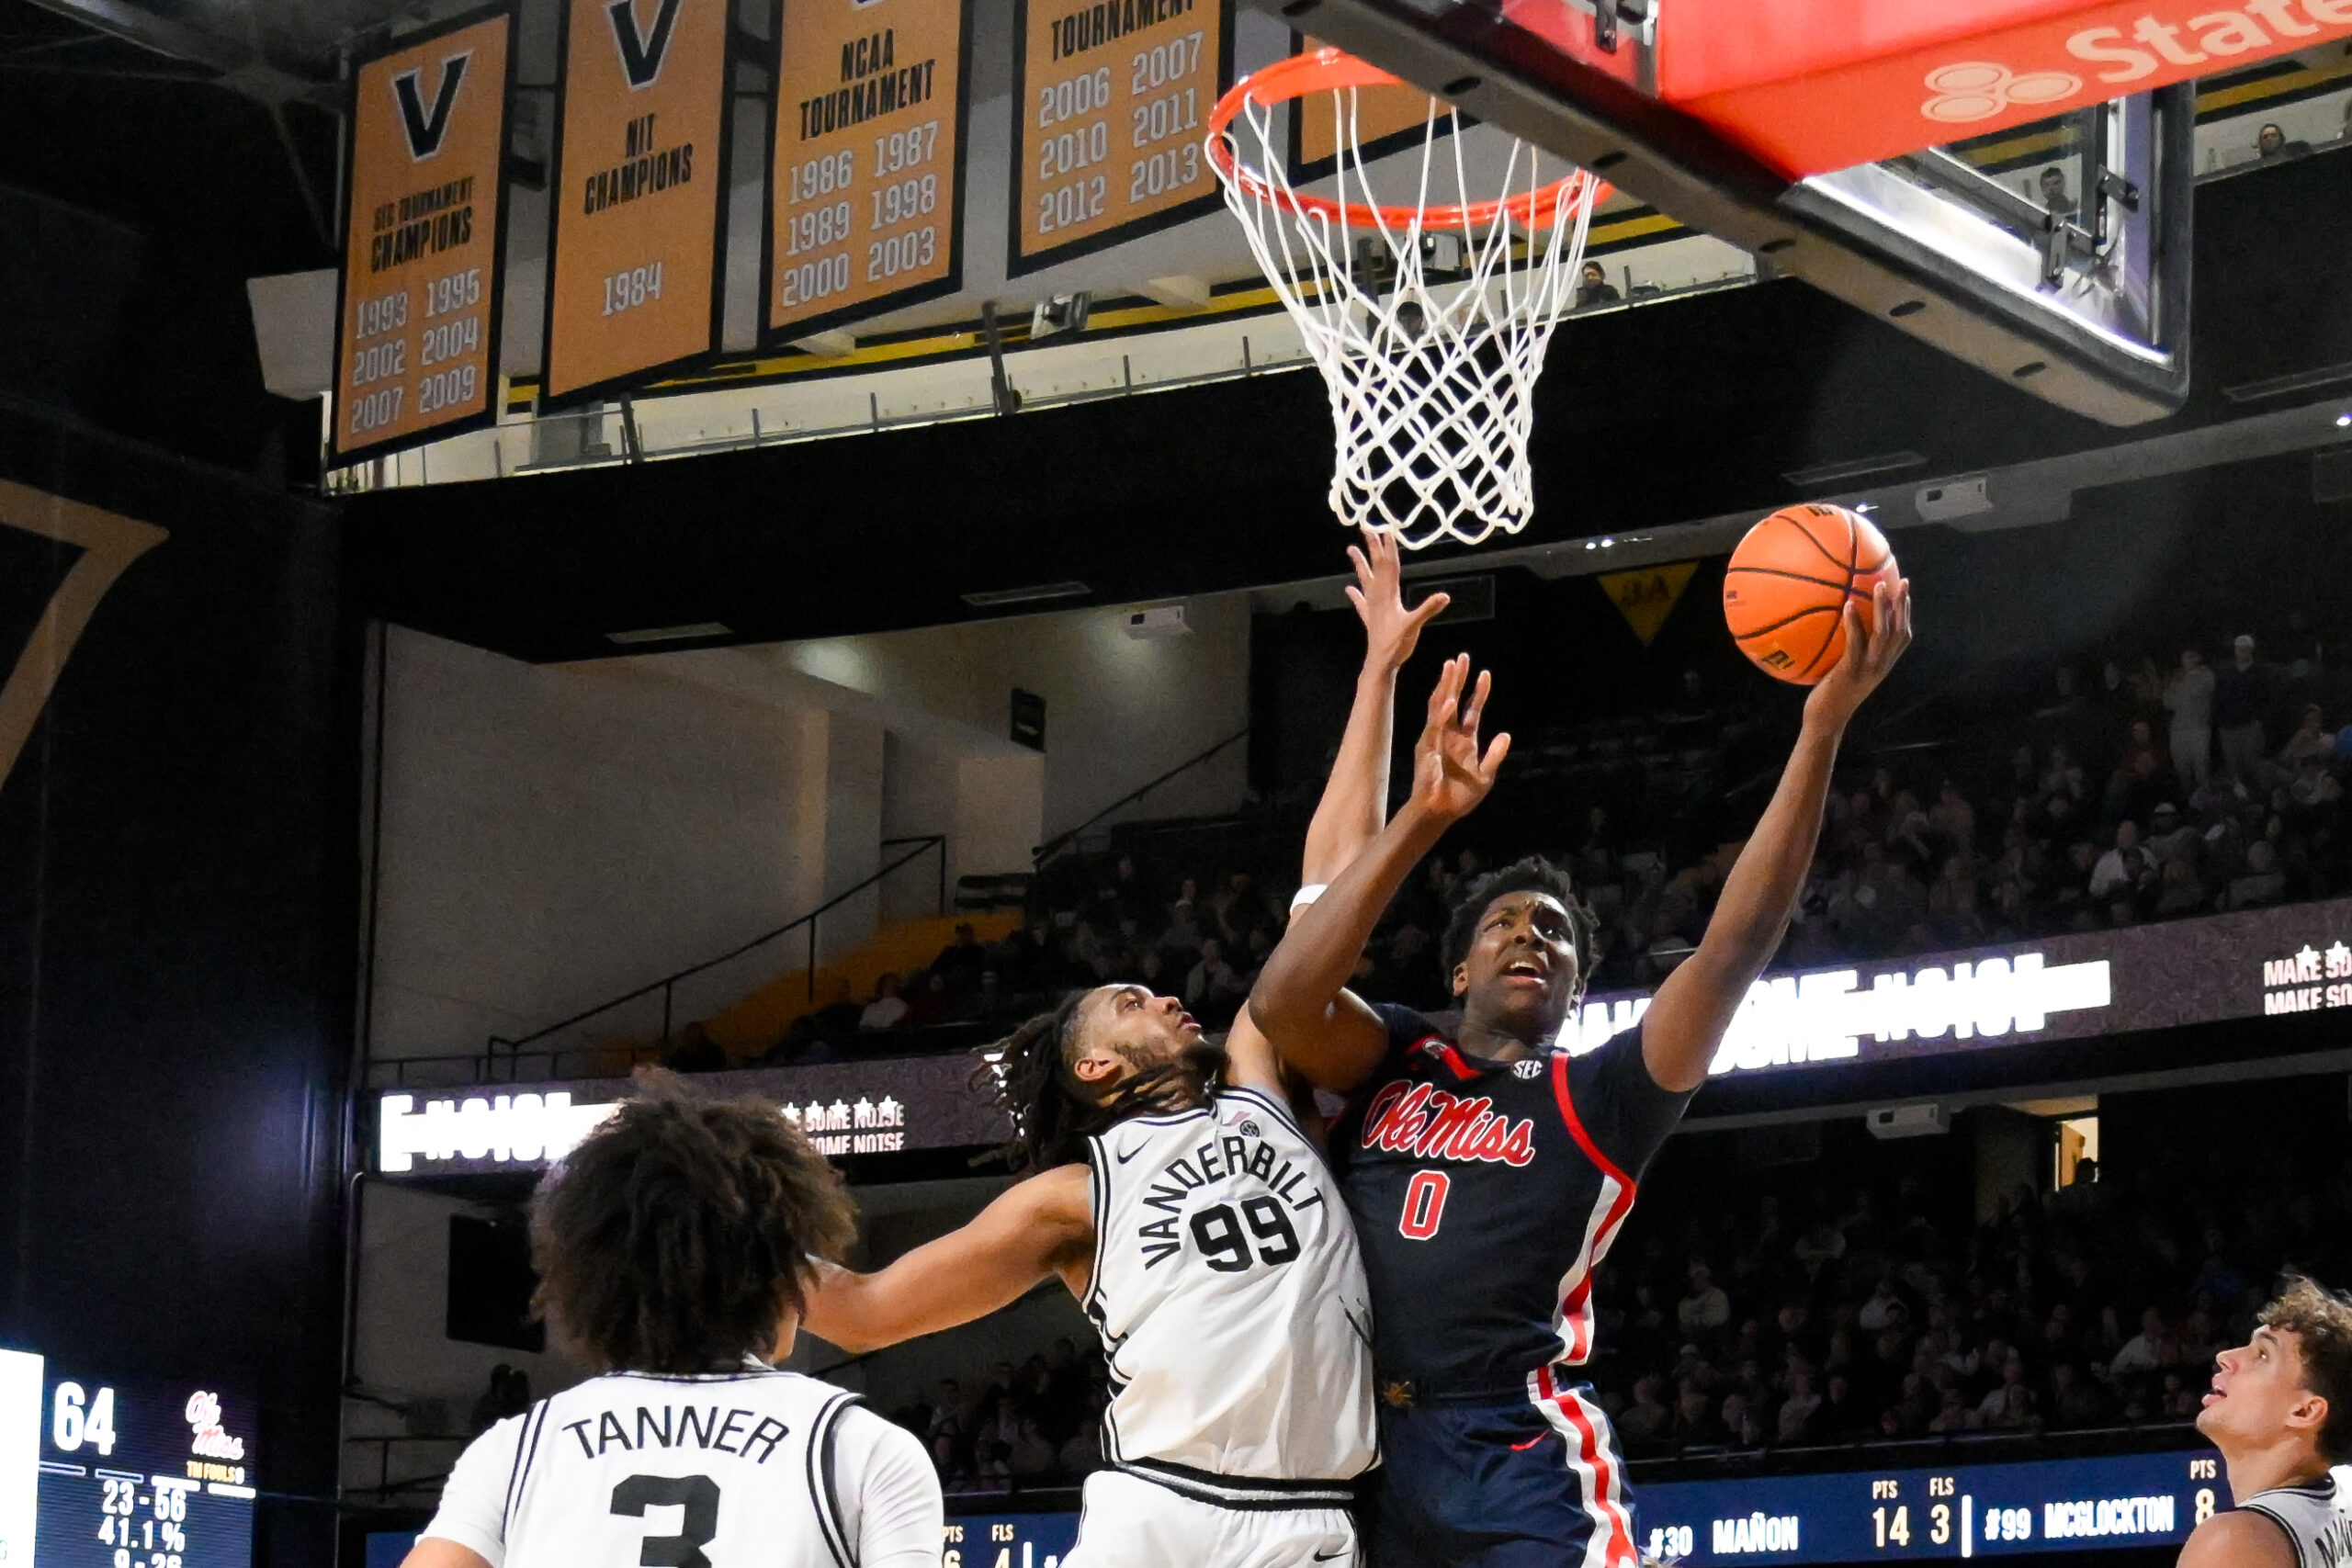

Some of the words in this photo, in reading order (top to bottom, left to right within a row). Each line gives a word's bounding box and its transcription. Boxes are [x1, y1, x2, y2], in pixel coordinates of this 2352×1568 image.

[841, 28, 895, 83] NCAA
[1051, 0, 1194, 62] TOURNAME
[2066, 0, 2352, 83] State
[393, 48, 474, 163] V
[799, 60, 936, 141] TOURNAMENT
[1039, 67, 1110, 130] 2006
[1131, 31, 1204, 96] 2007
[625, 114, 656, 157] NIT
[788, 149, 854, 204] 1986
[875, 120, 939, 177] 1987
[1039, 120, 1107, 180] 2010
[1132, 88, 1197, 148] 2011
[584, 143, 694, 215] CHAMPIONS
[786, 201, 851, 256] 1989
[870, 173, 936, 230] 1998
[1038, 175, 1106, 234] 2012
[1130, 142, 1199, 203] 2013
[371, 206, 472, 273] CHAMPIONS
[782, 253, 849, 307] 2000
[867, 226, 935, 282] 2003
[356, 291, 408, 340] 1993
[426, 268, 481, 318] 1995
[602, 261, 662, 316] 1984
[353, 339, 405, 387] 2002
[421, 317, 479, 366] 2004
[351, 385, 403, 434] 2007
[419, 365, 476, 413] 2009
[2264, 987, 2323, 1016] MAKE
[1512, 1059, 1544, 1080] SEC
[854, 1132, 905, 1154] NOISE
[1362, 1079, 1428, 1152] Ole
[1414, 1090, 1536, 1167] Miss
[1139, 1135, 1326, 1270] VANDERBILT
[1189, 1195, 1302, 1273] 99
[1399, 1169, 1451, 1240] 0
[54, 1381, 117, 1457] 64
[562, 1405, 790, 1464] TANNER
[1872, 1481, 1898, 1499] PTS
[1929, 1477, 1954, 1496] FLS
[2190, 1460, 2216, 1480] PTS
[610, 1474, 720, 1568] 3
[943, 1525, 964, 1543] PTS
[991, 1524, 1014, 1542] FLS
[1649, 1526, 1693, 1559] #30
[1713, 1511, 1799, 1554] MAÑON
[1872, 1506, 1910, 1547] 14
[1930, 1504, 1951, 1544] 3
[1984, 1507, 2032, 1541] #99
[2044, 1495, 2175, 1540] MCGLOCKTON
[2195, 1488, 2215, 1527] 8
